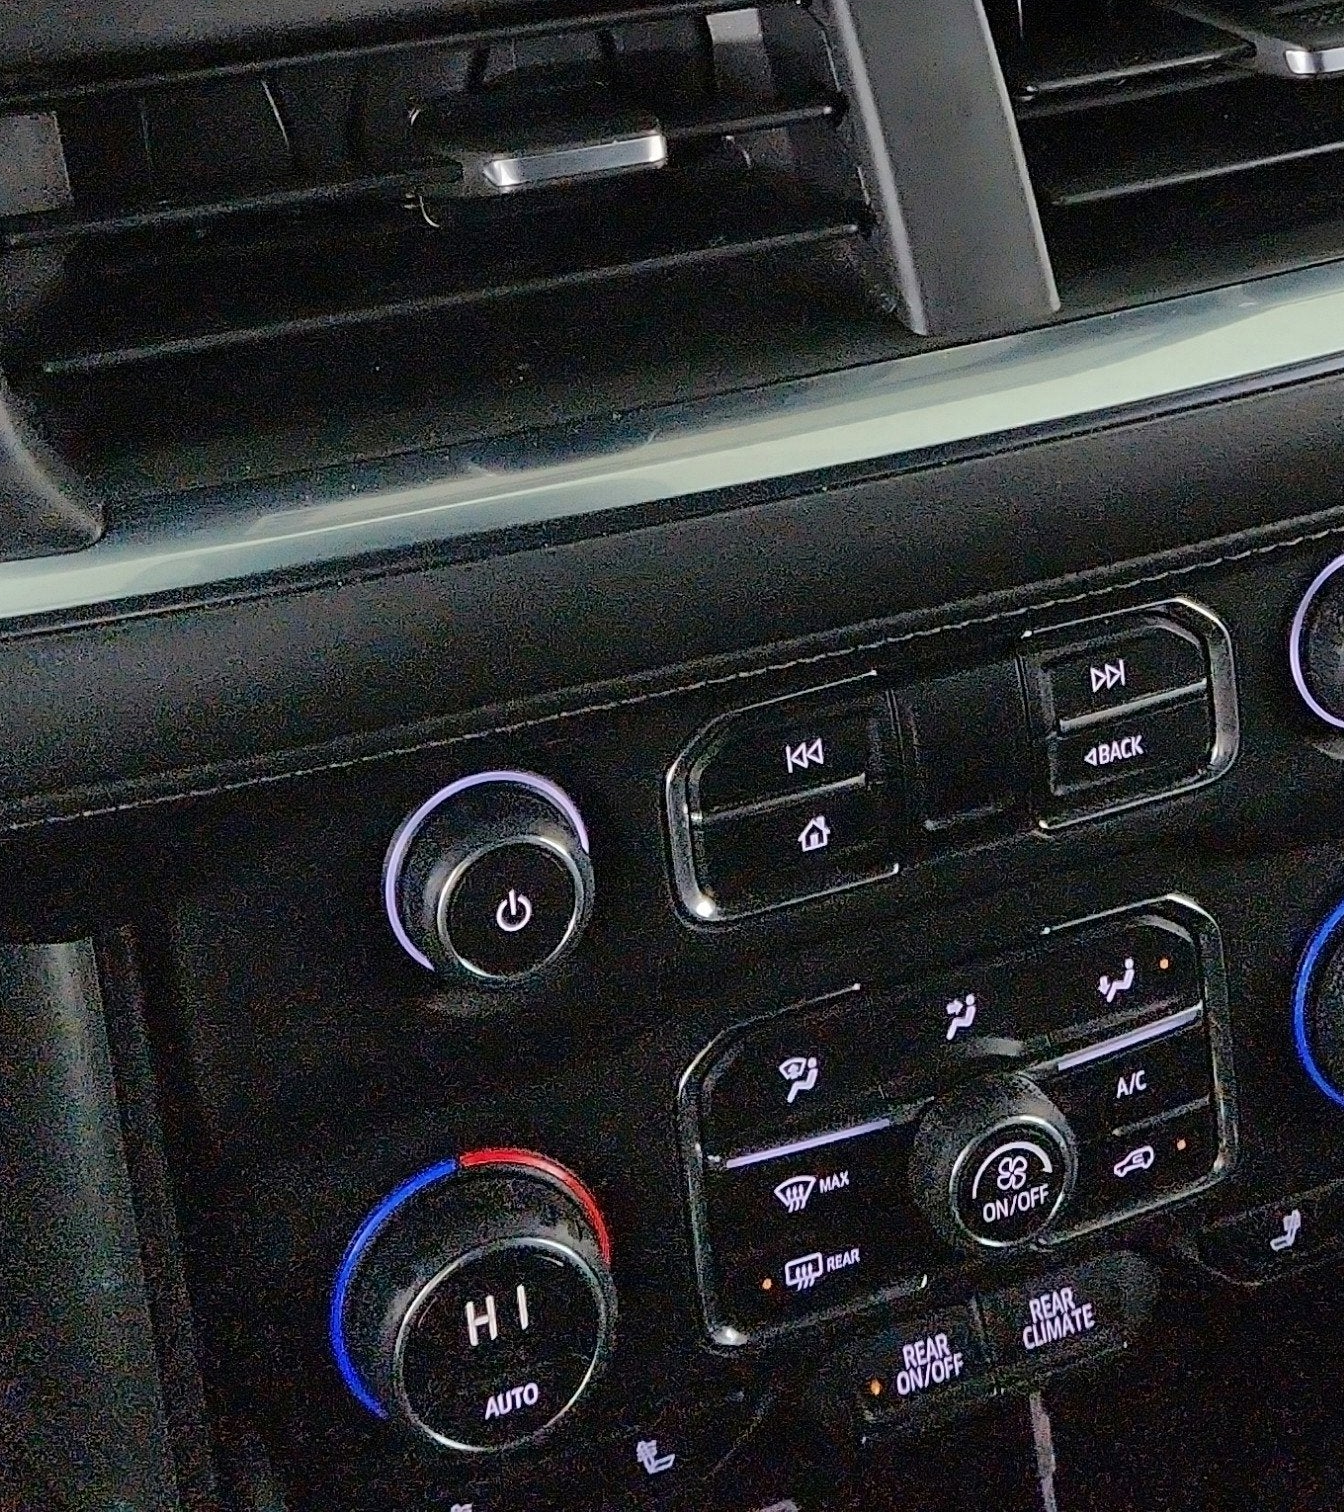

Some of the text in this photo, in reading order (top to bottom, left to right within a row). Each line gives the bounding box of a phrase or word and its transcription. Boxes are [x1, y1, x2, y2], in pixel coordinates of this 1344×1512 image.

[1096, 734, 1144, 764] BACK
[1115, 1069, 1148, 1099] A/C
[819, 1170, 851, 1194] MAX
[982, 1184, 1051, 1224] ON/OFF
[826, 1247, 861, 1271] REAR
[1029, 1286, 1076, 1324] REAR
[1022, 1302, 1096, 1350] CLIMATE
[902, 1332, 951, 1370] REAR
[896, 1352, 965, 1396] ON/OFF
[484, 1382, 539, 1420] AUTO
